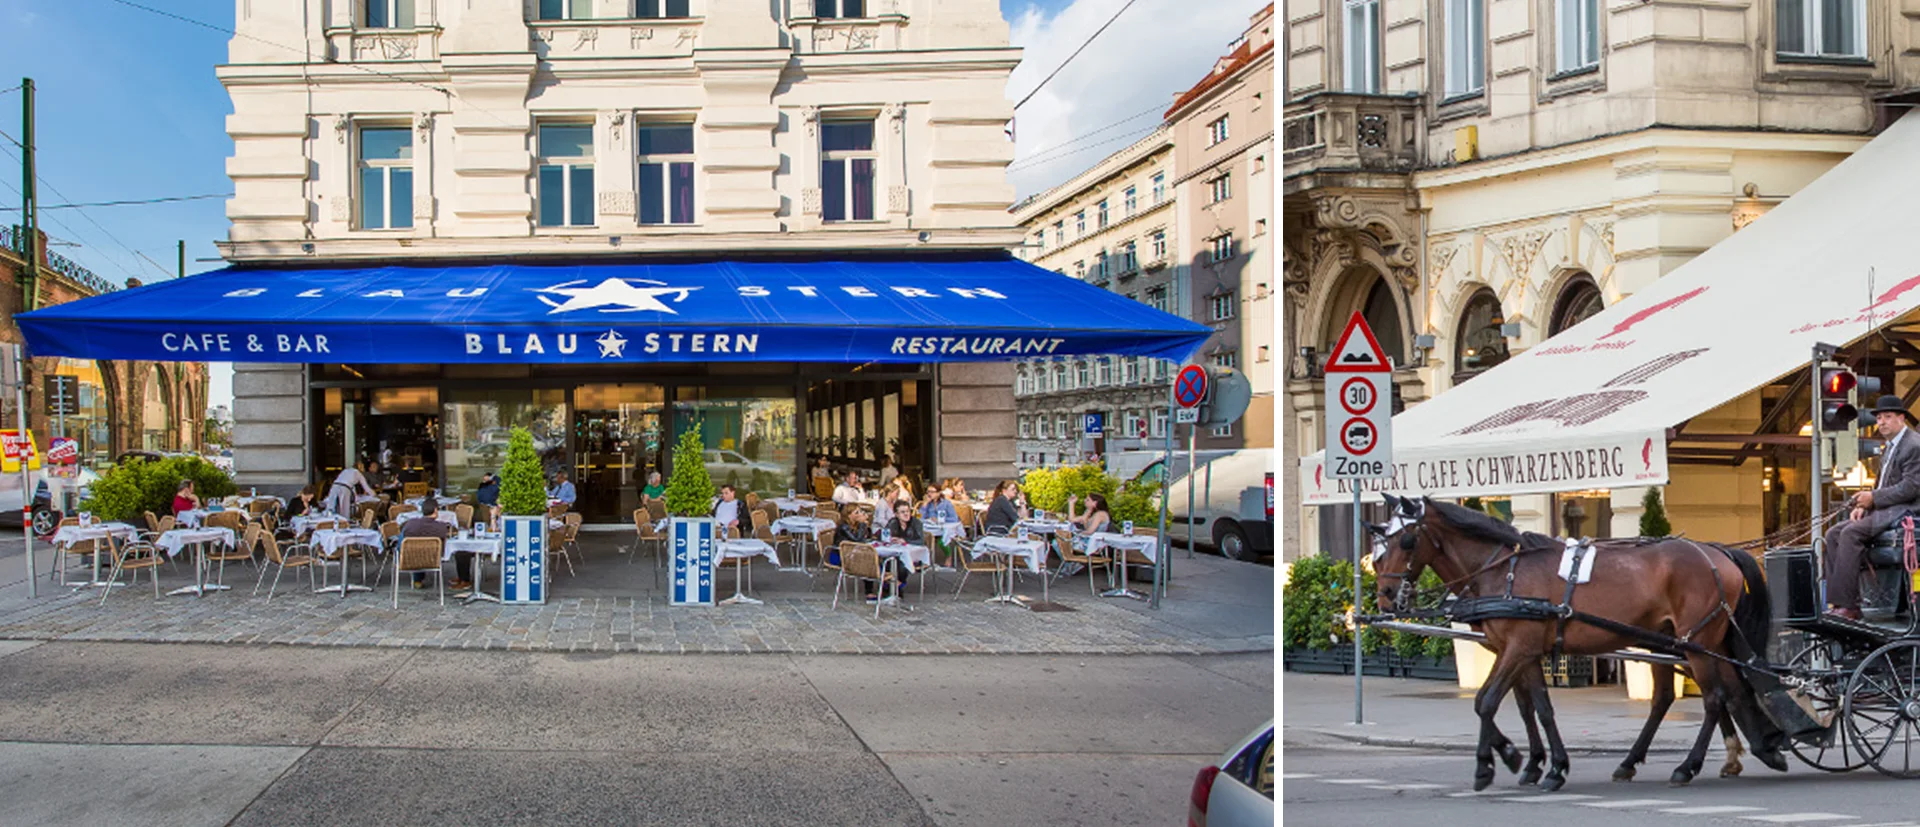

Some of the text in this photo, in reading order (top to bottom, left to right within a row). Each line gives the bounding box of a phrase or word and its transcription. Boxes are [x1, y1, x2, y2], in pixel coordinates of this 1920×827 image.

[736, 285, 1008, 299] STERN
[161, 332, 331, 354] CAFE & BAR
[464, 332, 760, 354] BLAU STERN
[890, 336, 1065, 355] RESTAURANT
[1349, 386, 1367, 405] 30
[1086, 415, 1096, 428] P
[1335, 456, 1384, 475] Zone
[1417, 459, 1460, 490] CAFE
[1466, 446, 1625, 486] SCHWARZENBERG
[505, 536, 516, 585] STERN
[530, 536, 541, 585] BLAU
[676, 537, 687, 587] BLAU
[699, 537, 710, 587] STERN
